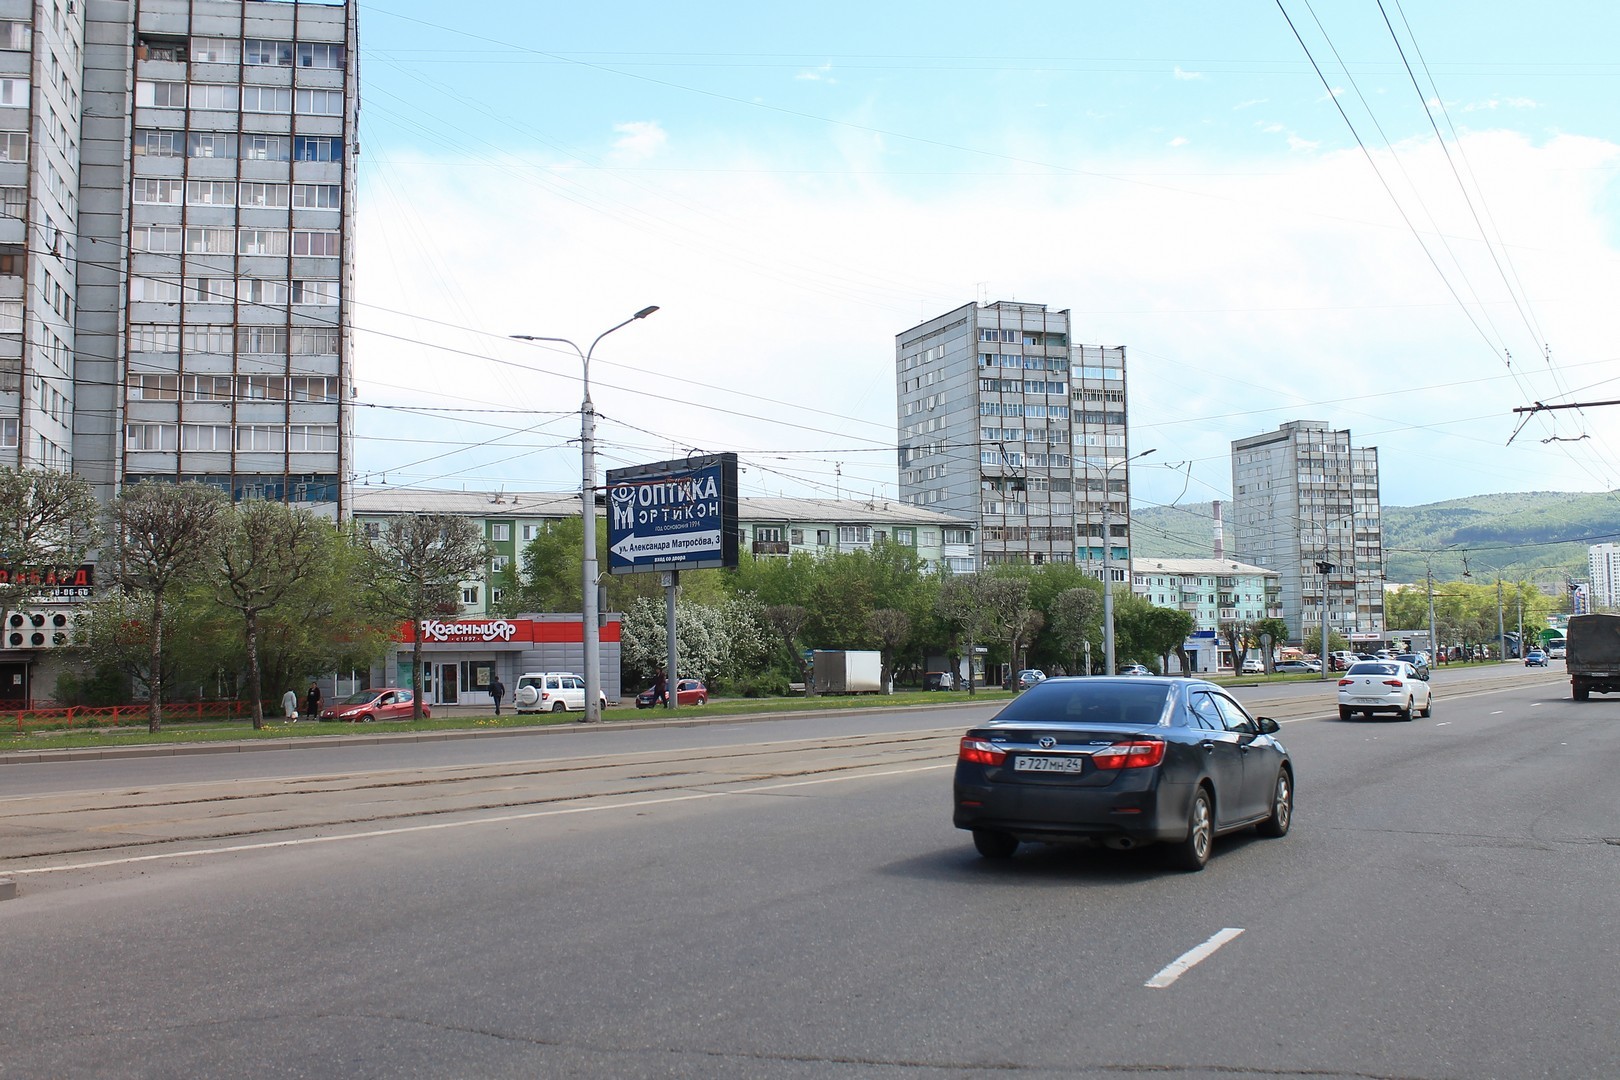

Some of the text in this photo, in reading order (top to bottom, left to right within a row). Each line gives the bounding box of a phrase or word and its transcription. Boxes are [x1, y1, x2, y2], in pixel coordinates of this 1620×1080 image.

[639, 476, 718, 507] ОПТИКА
[629, 541, 670, 552] Александра
[715, 535, 720, 544] 3
